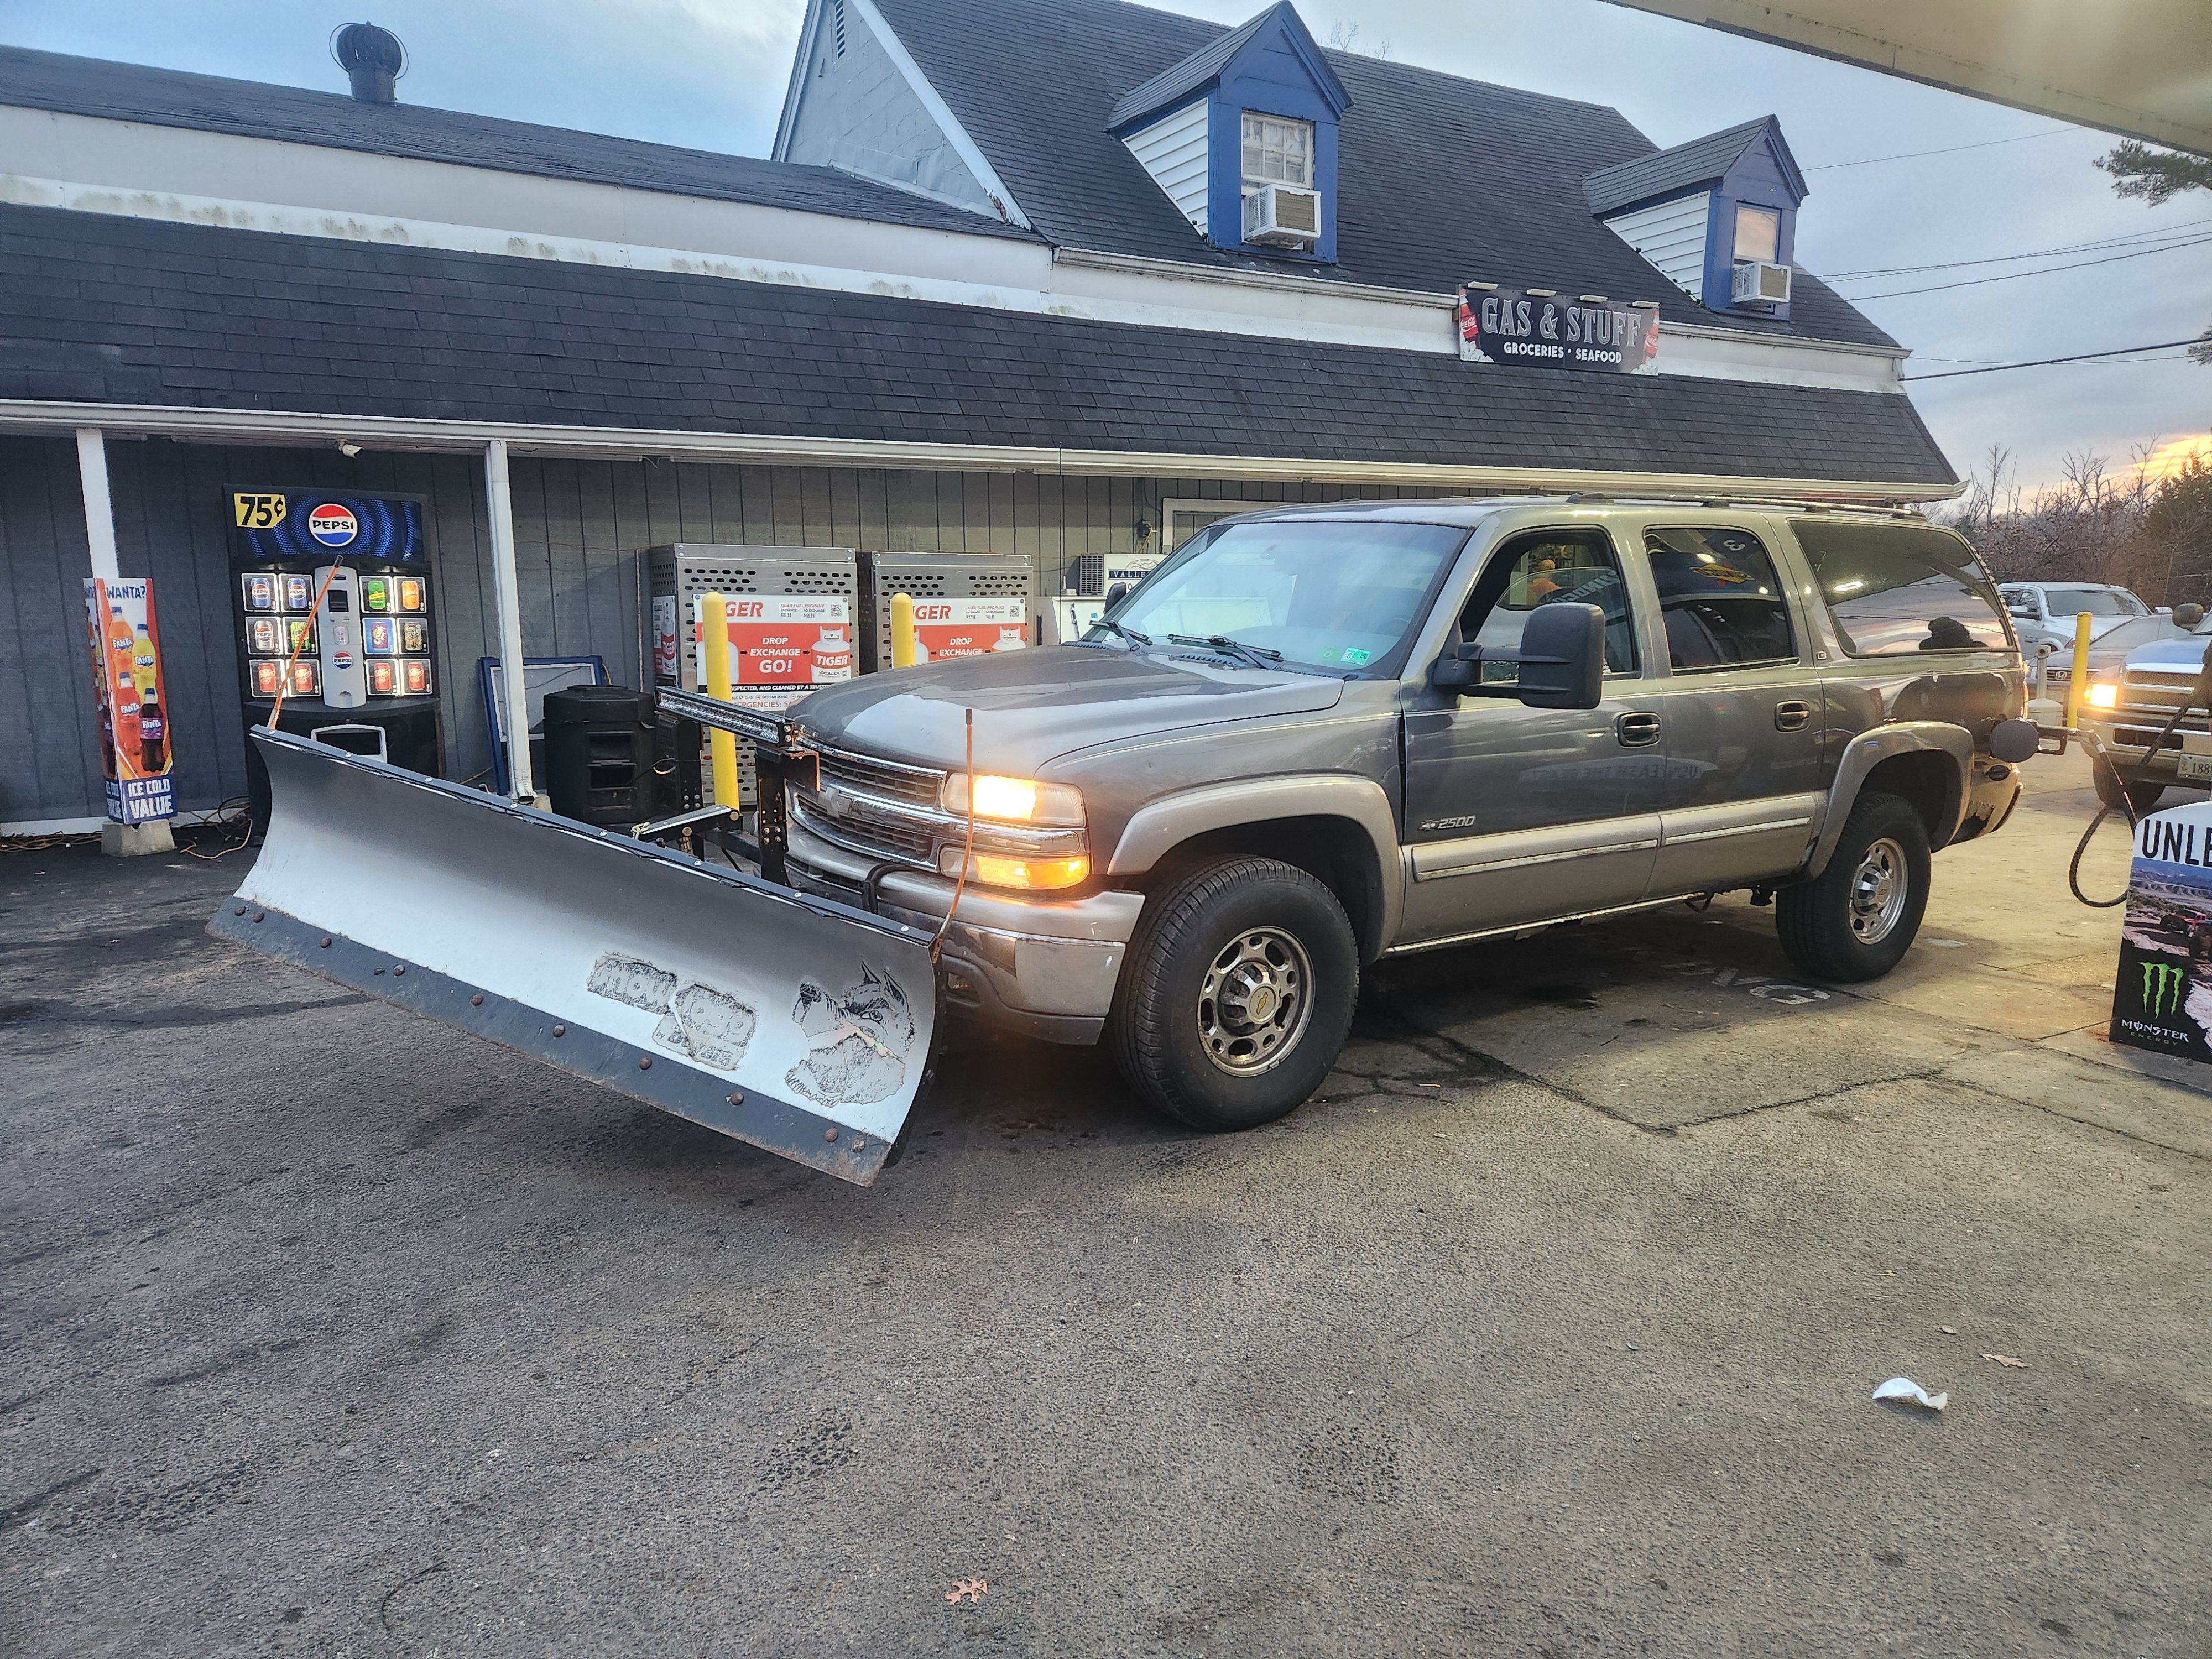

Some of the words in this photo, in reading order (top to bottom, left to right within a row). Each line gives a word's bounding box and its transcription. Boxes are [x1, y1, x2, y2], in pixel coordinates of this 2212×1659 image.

[1481, 297, 1532, 337] GAS
[1540, 304, 1559, 340] &
[1566, 306, 1642, 347] STUFF
[1504, 341, 1564, 358] GROCERIES
[1575, 348, 1622, 363] SEAFOOD
[312, 520, 354, 530] PEPSI
[106, 586, 146, 599] WANTA?
[726, 601, 763, 617] GER
[913, 605, 951, 620] GER
[112, 638, 133, 648] FANTA
[135, 655, 154, 665] FANTA
[759, 659, 792, 673] GO!
[816, 655, 848, 666] TIGER
[120, 703, 140, 714] FANTA
[142, 719, 162, 729] FANTA
[2193, 763, 2212, 775] 188
[128, 781, 144, 797] ICE
[146, 779, 170, 795] COLD
[129, 795, 174, 819] VALUE
[1438, 815, 1475, 828] 2500
[2142, 819, 2212, 867] UNLE
[655, 1030, 665, 1040] by
[2121, 1019, 2189, 1042] MONSTER
[2130, 1032, 2178, 1045] ENERGY
